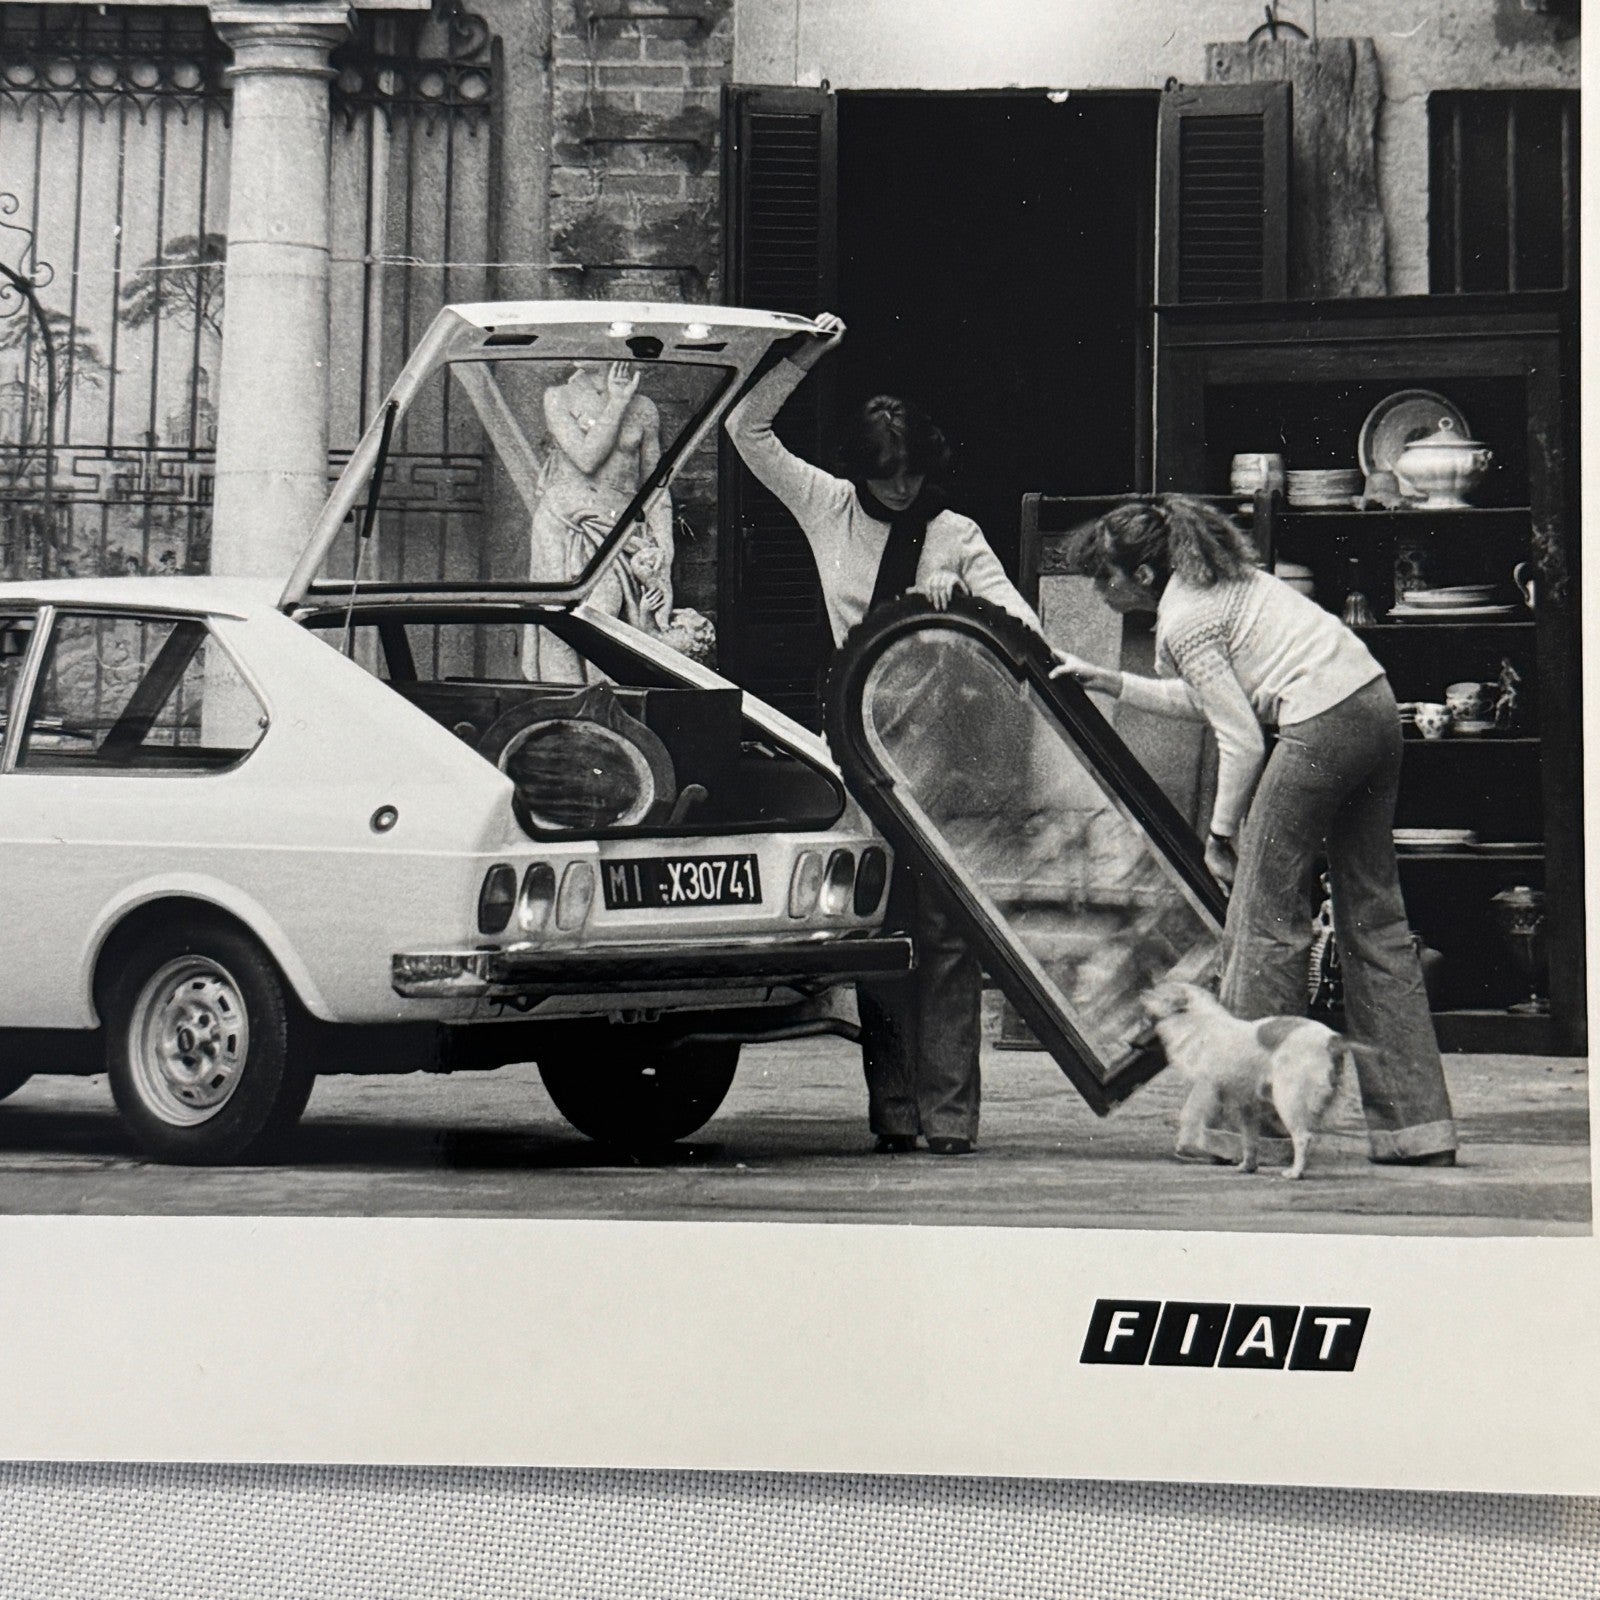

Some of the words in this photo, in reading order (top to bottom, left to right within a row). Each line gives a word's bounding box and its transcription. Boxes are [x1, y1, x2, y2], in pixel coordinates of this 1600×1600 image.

[609, 864, 643, 903] MI
[667, 860, 755, 902] X30741
[1102, 1310, 1353, 1361] FIAT
